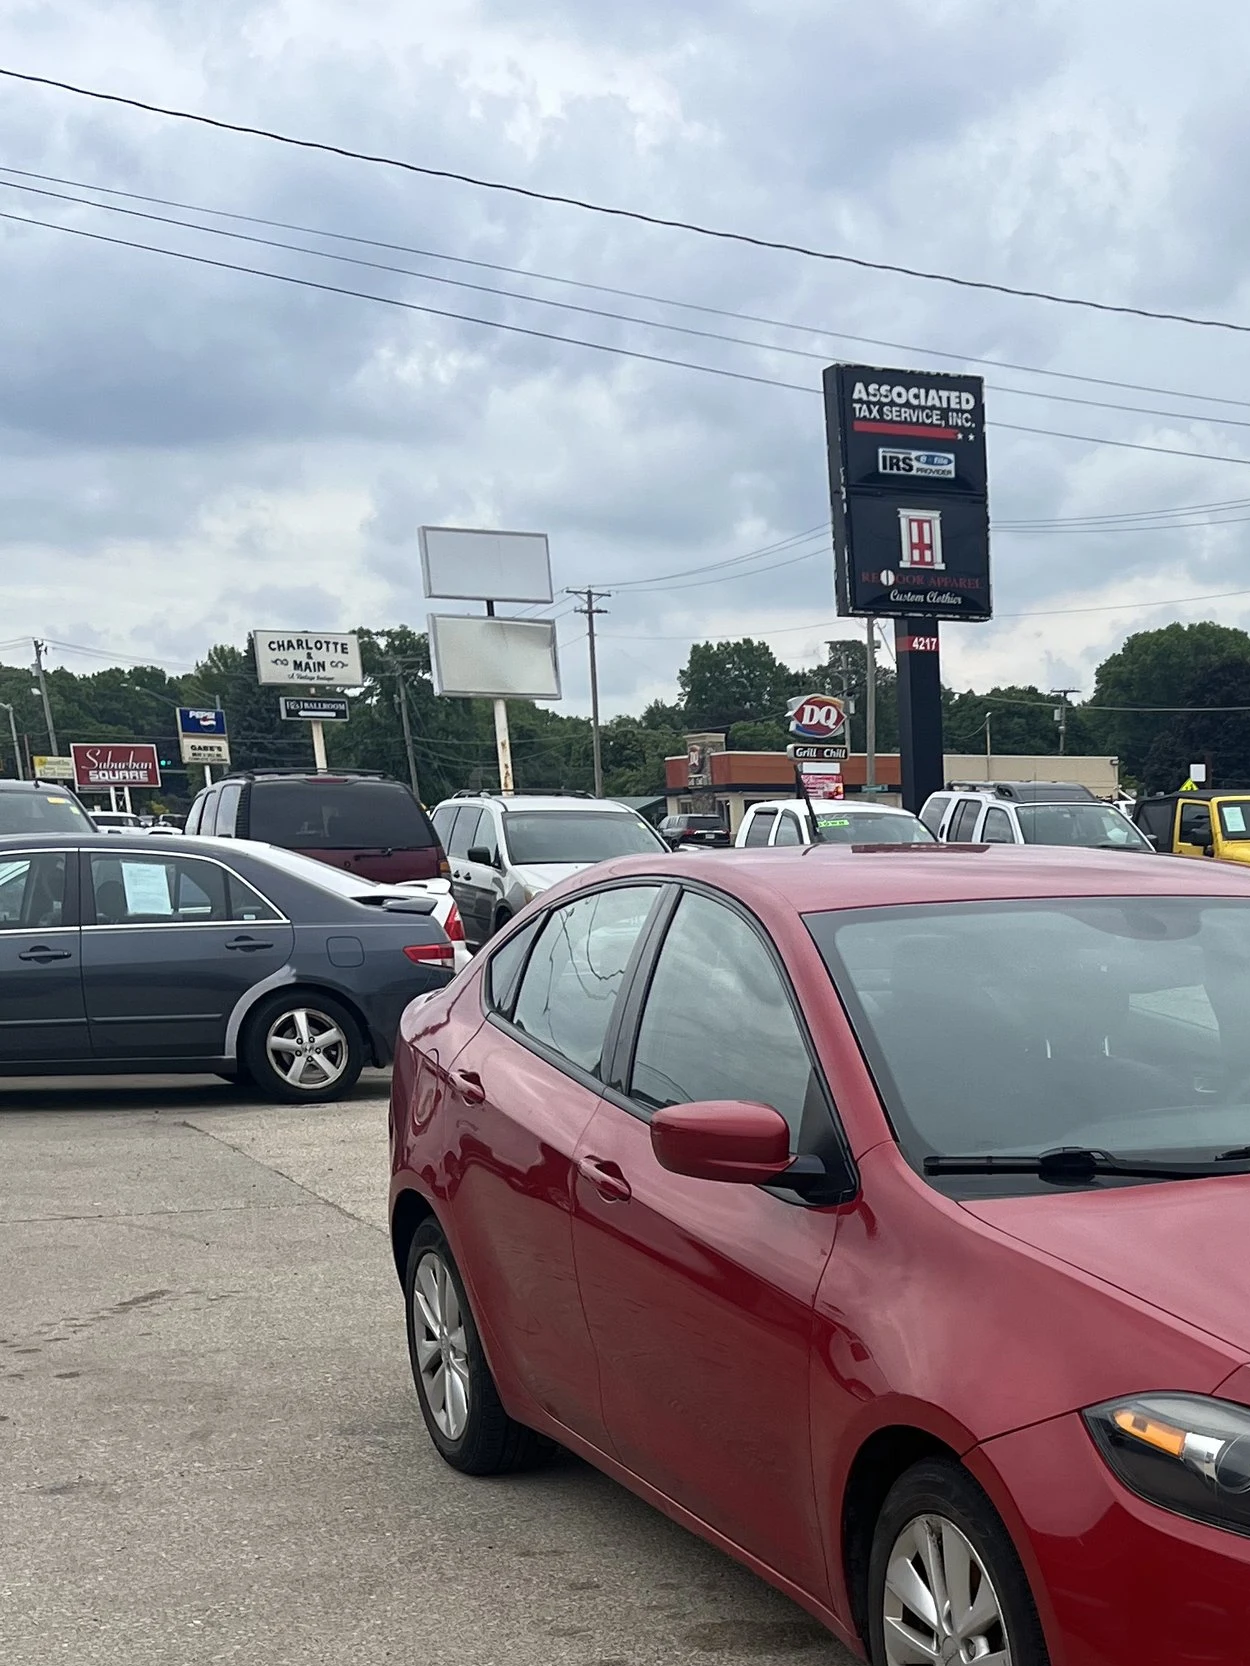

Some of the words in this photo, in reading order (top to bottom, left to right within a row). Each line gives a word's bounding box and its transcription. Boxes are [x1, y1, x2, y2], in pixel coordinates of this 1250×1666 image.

[852, 382, 975, 411] ASSOCIATED
[853, 403, 881, 420] TAX
[883, 406, 945, 428] SERVICE,
[948, 411, 976, 428] INC.
[881, 454, 914, 473] IRS
[915, 467, 953, 477] PROVIDER
[927, 576, 980, 590] APPAREL
[890, 589, 924, 603] Custom
[268, 639, 349, 655] CHARLOTTE
[912, 637, 938, 650] 4217
[306, 652, 314, 660] &
[293, 660, 326, 673] MAIN
[304, 702, 345, 711] BALLROOM
[801, 704, 839, 730] DQ
[81, 748, 152, 770] Suburban
[796, 747, 817, 758] Grill
[823, 748, 847, 759] Chill
[88, 770, 149, 782] SQUARE
